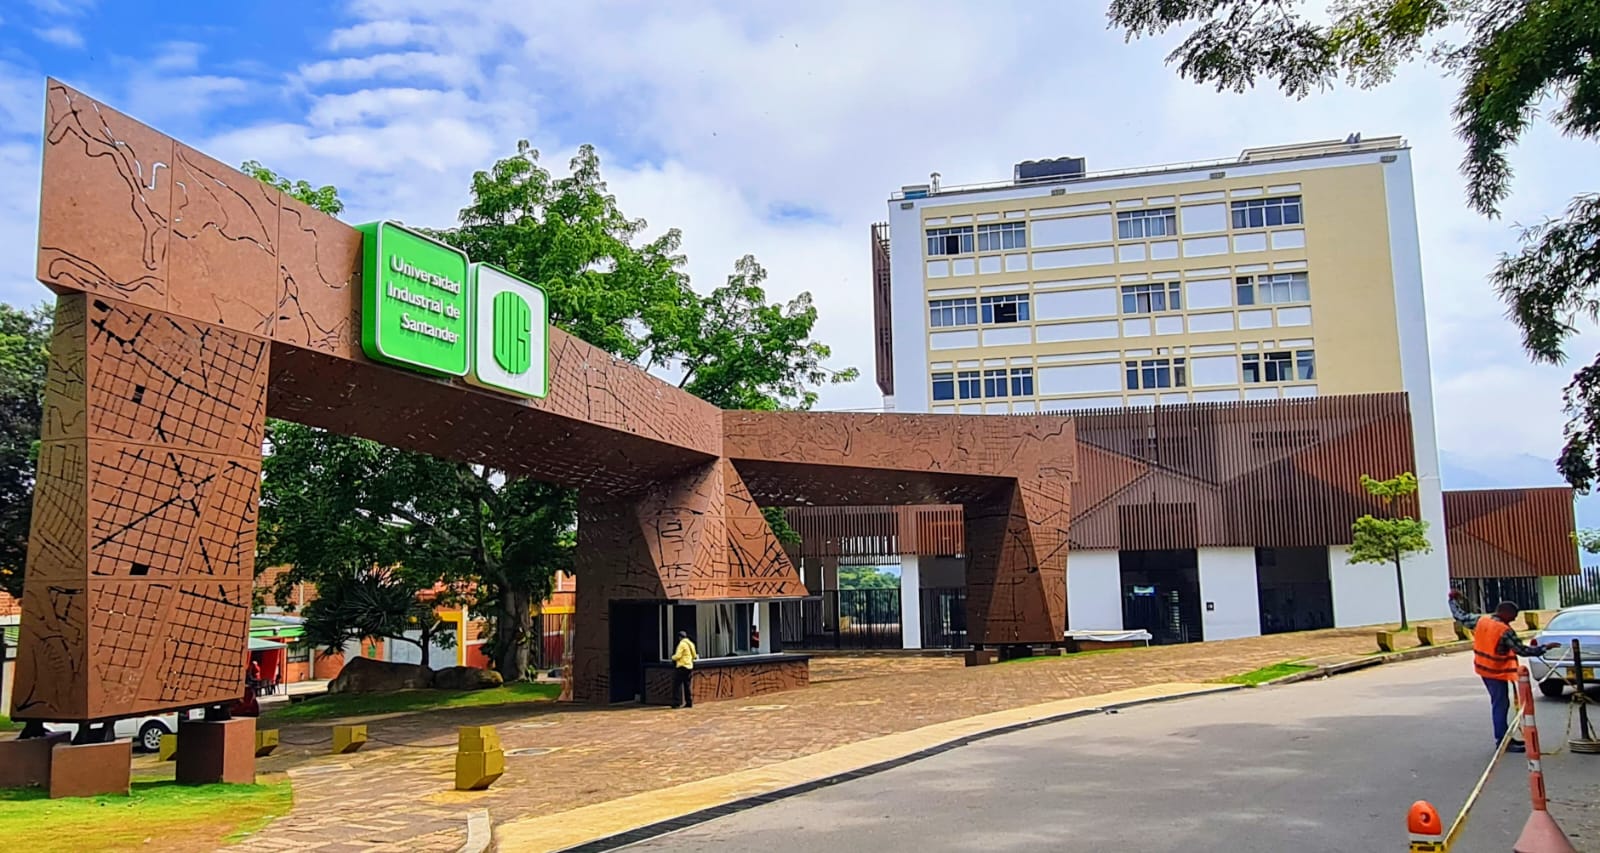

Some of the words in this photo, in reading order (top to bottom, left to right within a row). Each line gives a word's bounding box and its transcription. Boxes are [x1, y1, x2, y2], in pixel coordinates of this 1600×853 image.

[390, 254, 460, 294] Universidad
[387, 281, 443, 313] Industrial
[445, 303, 460, 319] de
[401, 312, 459, 343] Santander
